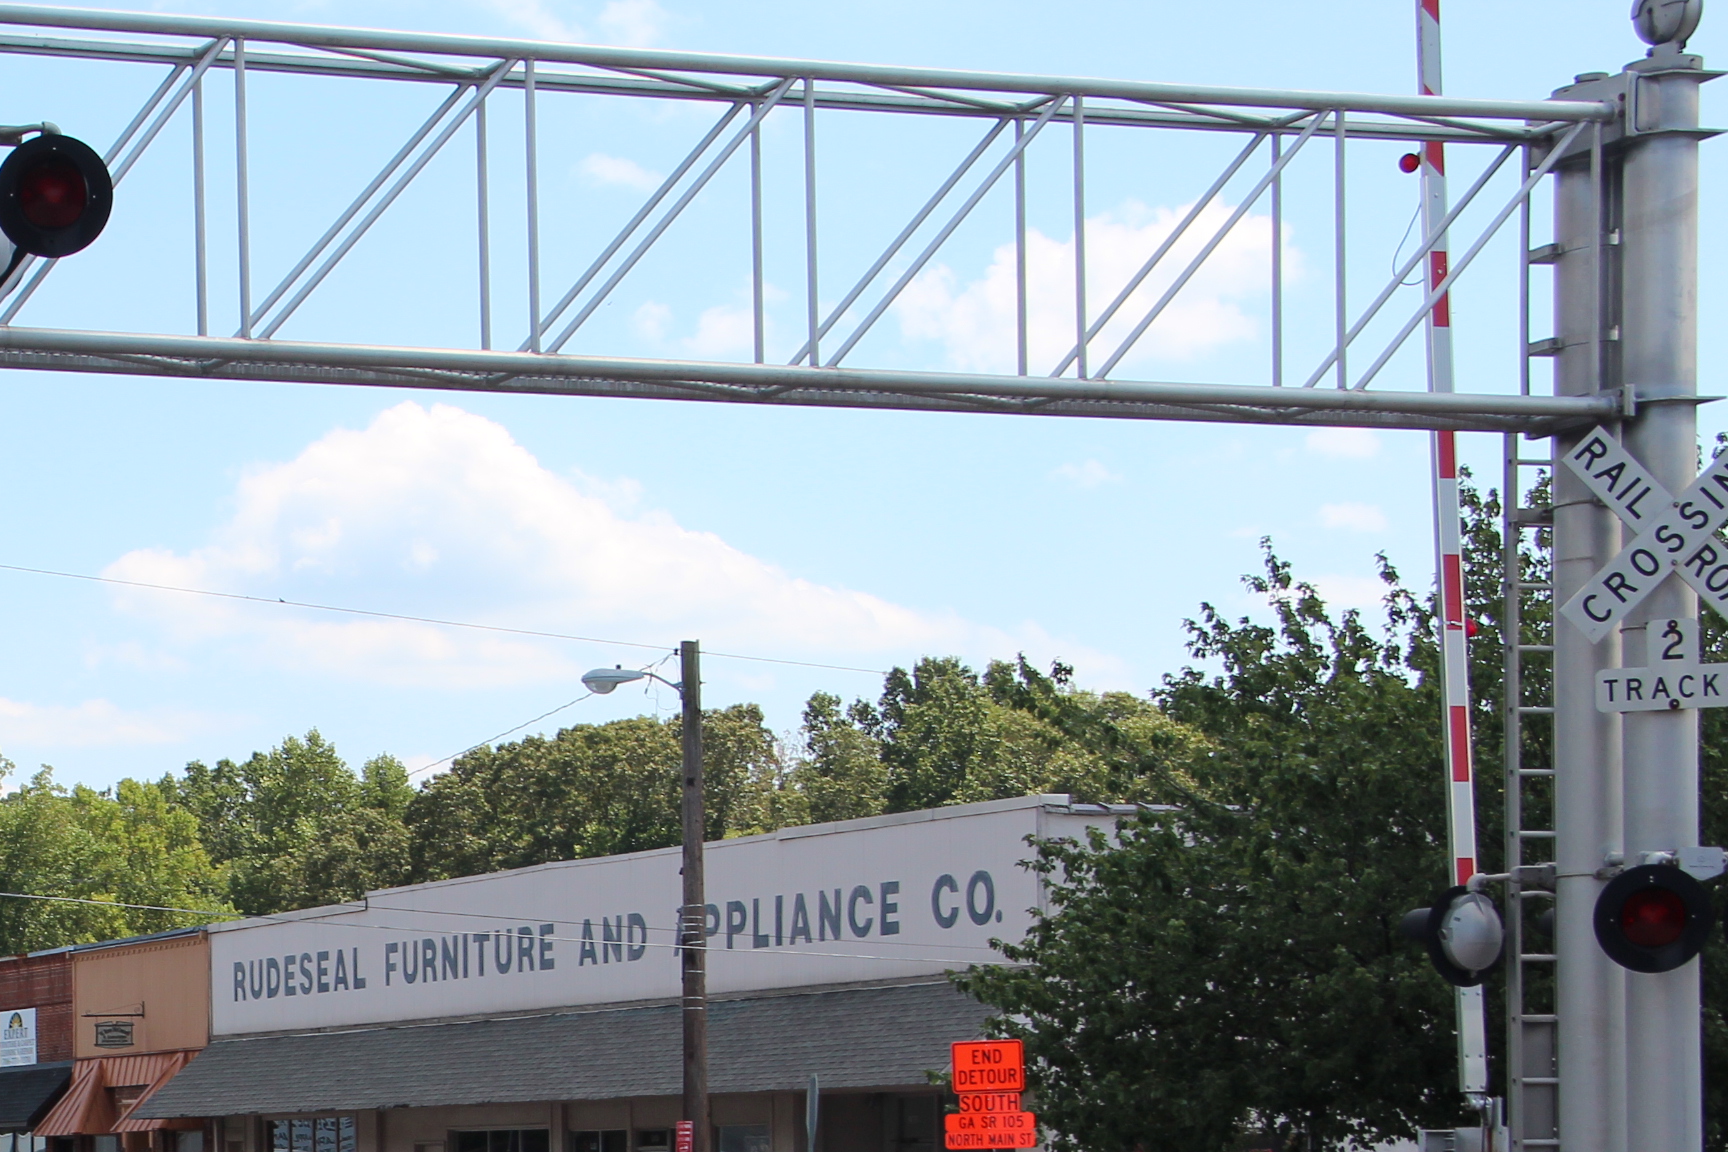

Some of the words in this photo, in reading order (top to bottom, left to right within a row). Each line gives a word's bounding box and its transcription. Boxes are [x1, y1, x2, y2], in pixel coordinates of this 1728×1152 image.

[1574, 437, 1651, 520] RAIL
[1684, 543, 1728, 601] RO
[1661, 624, 1684, 660] 2
[1603, 673, 1720, 702] TRACK
[233, 947, 366, 1002] RUDESEAL
[385, 924, 555, 986] FURNITURE
[579, 913, 647, 966] AND
[932, 870, 1003, 929] CO.
[3, 1027, 28, 1040] EXPERT
[972, 1049, 1002, 1065] END
[958, 1068, 1017, 1085] DETOUR
[960, 1094, 1018, 1112] SOUTH
[959, 1116, 975, 1129] GA
[981, 1116, 996, 1129] SR
[1003, 1115, 1024, 1128] 105
[947, 1133, 983, 1147] NORTH
[988, 1133, 1014, 1146] MAIN
[1020, 1132, 1031, 1145] ST
